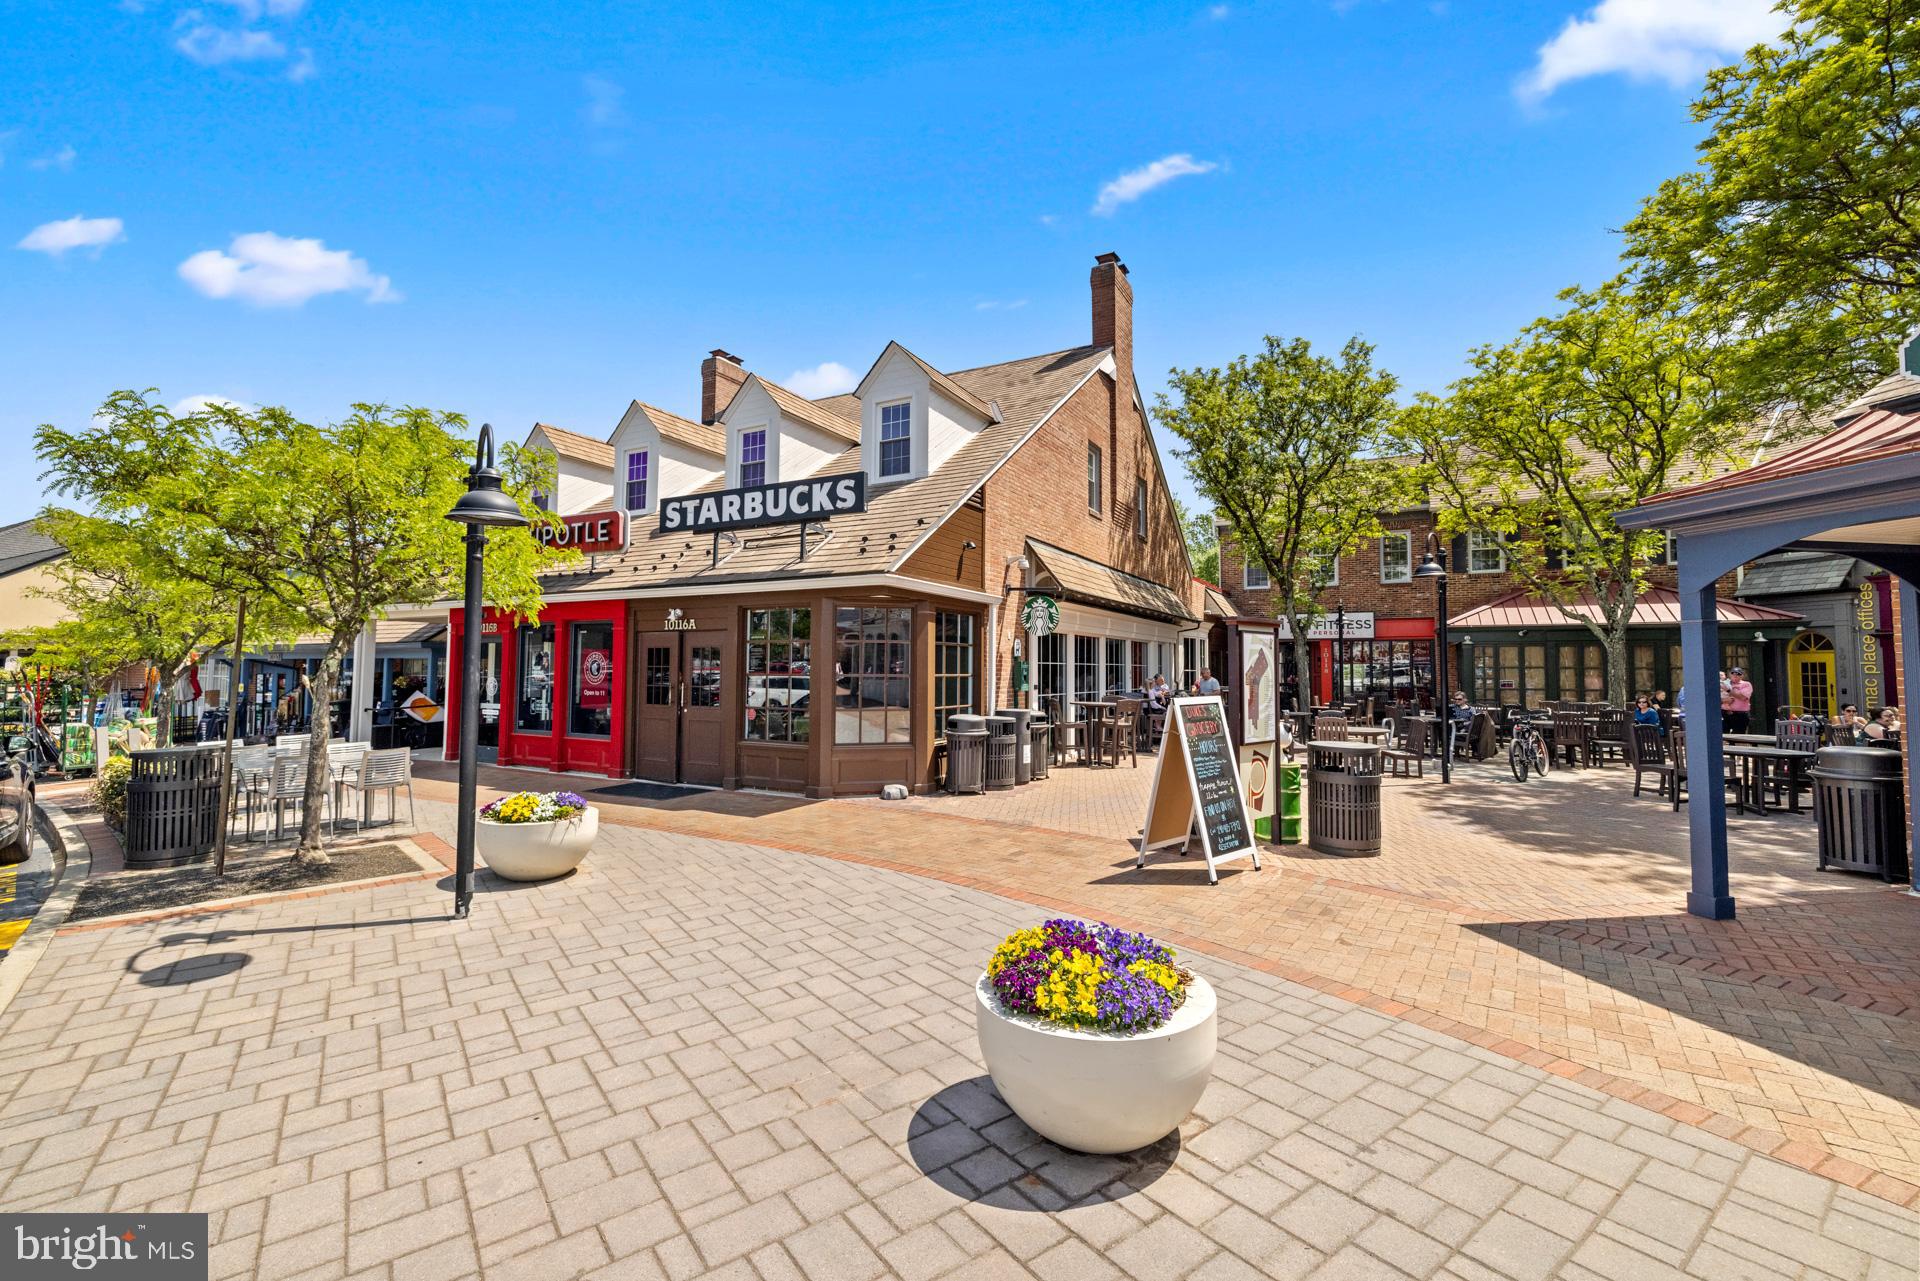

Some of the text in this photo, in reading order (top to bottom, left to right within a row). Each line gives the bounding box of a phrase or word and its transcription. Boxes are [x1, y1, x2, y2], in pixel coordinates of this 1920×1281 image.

[664, 479, 856, 529] STARBUCKS
[530, 518, 611, 545] IPOTLE
[1857, 582, 1875, 631] offices
[480, 623, 498, 633] 116B
[664, 619, 696, 630] 10116A
[1863, 634, 1881, 674] place
[583, 689, 594, 697] Open
